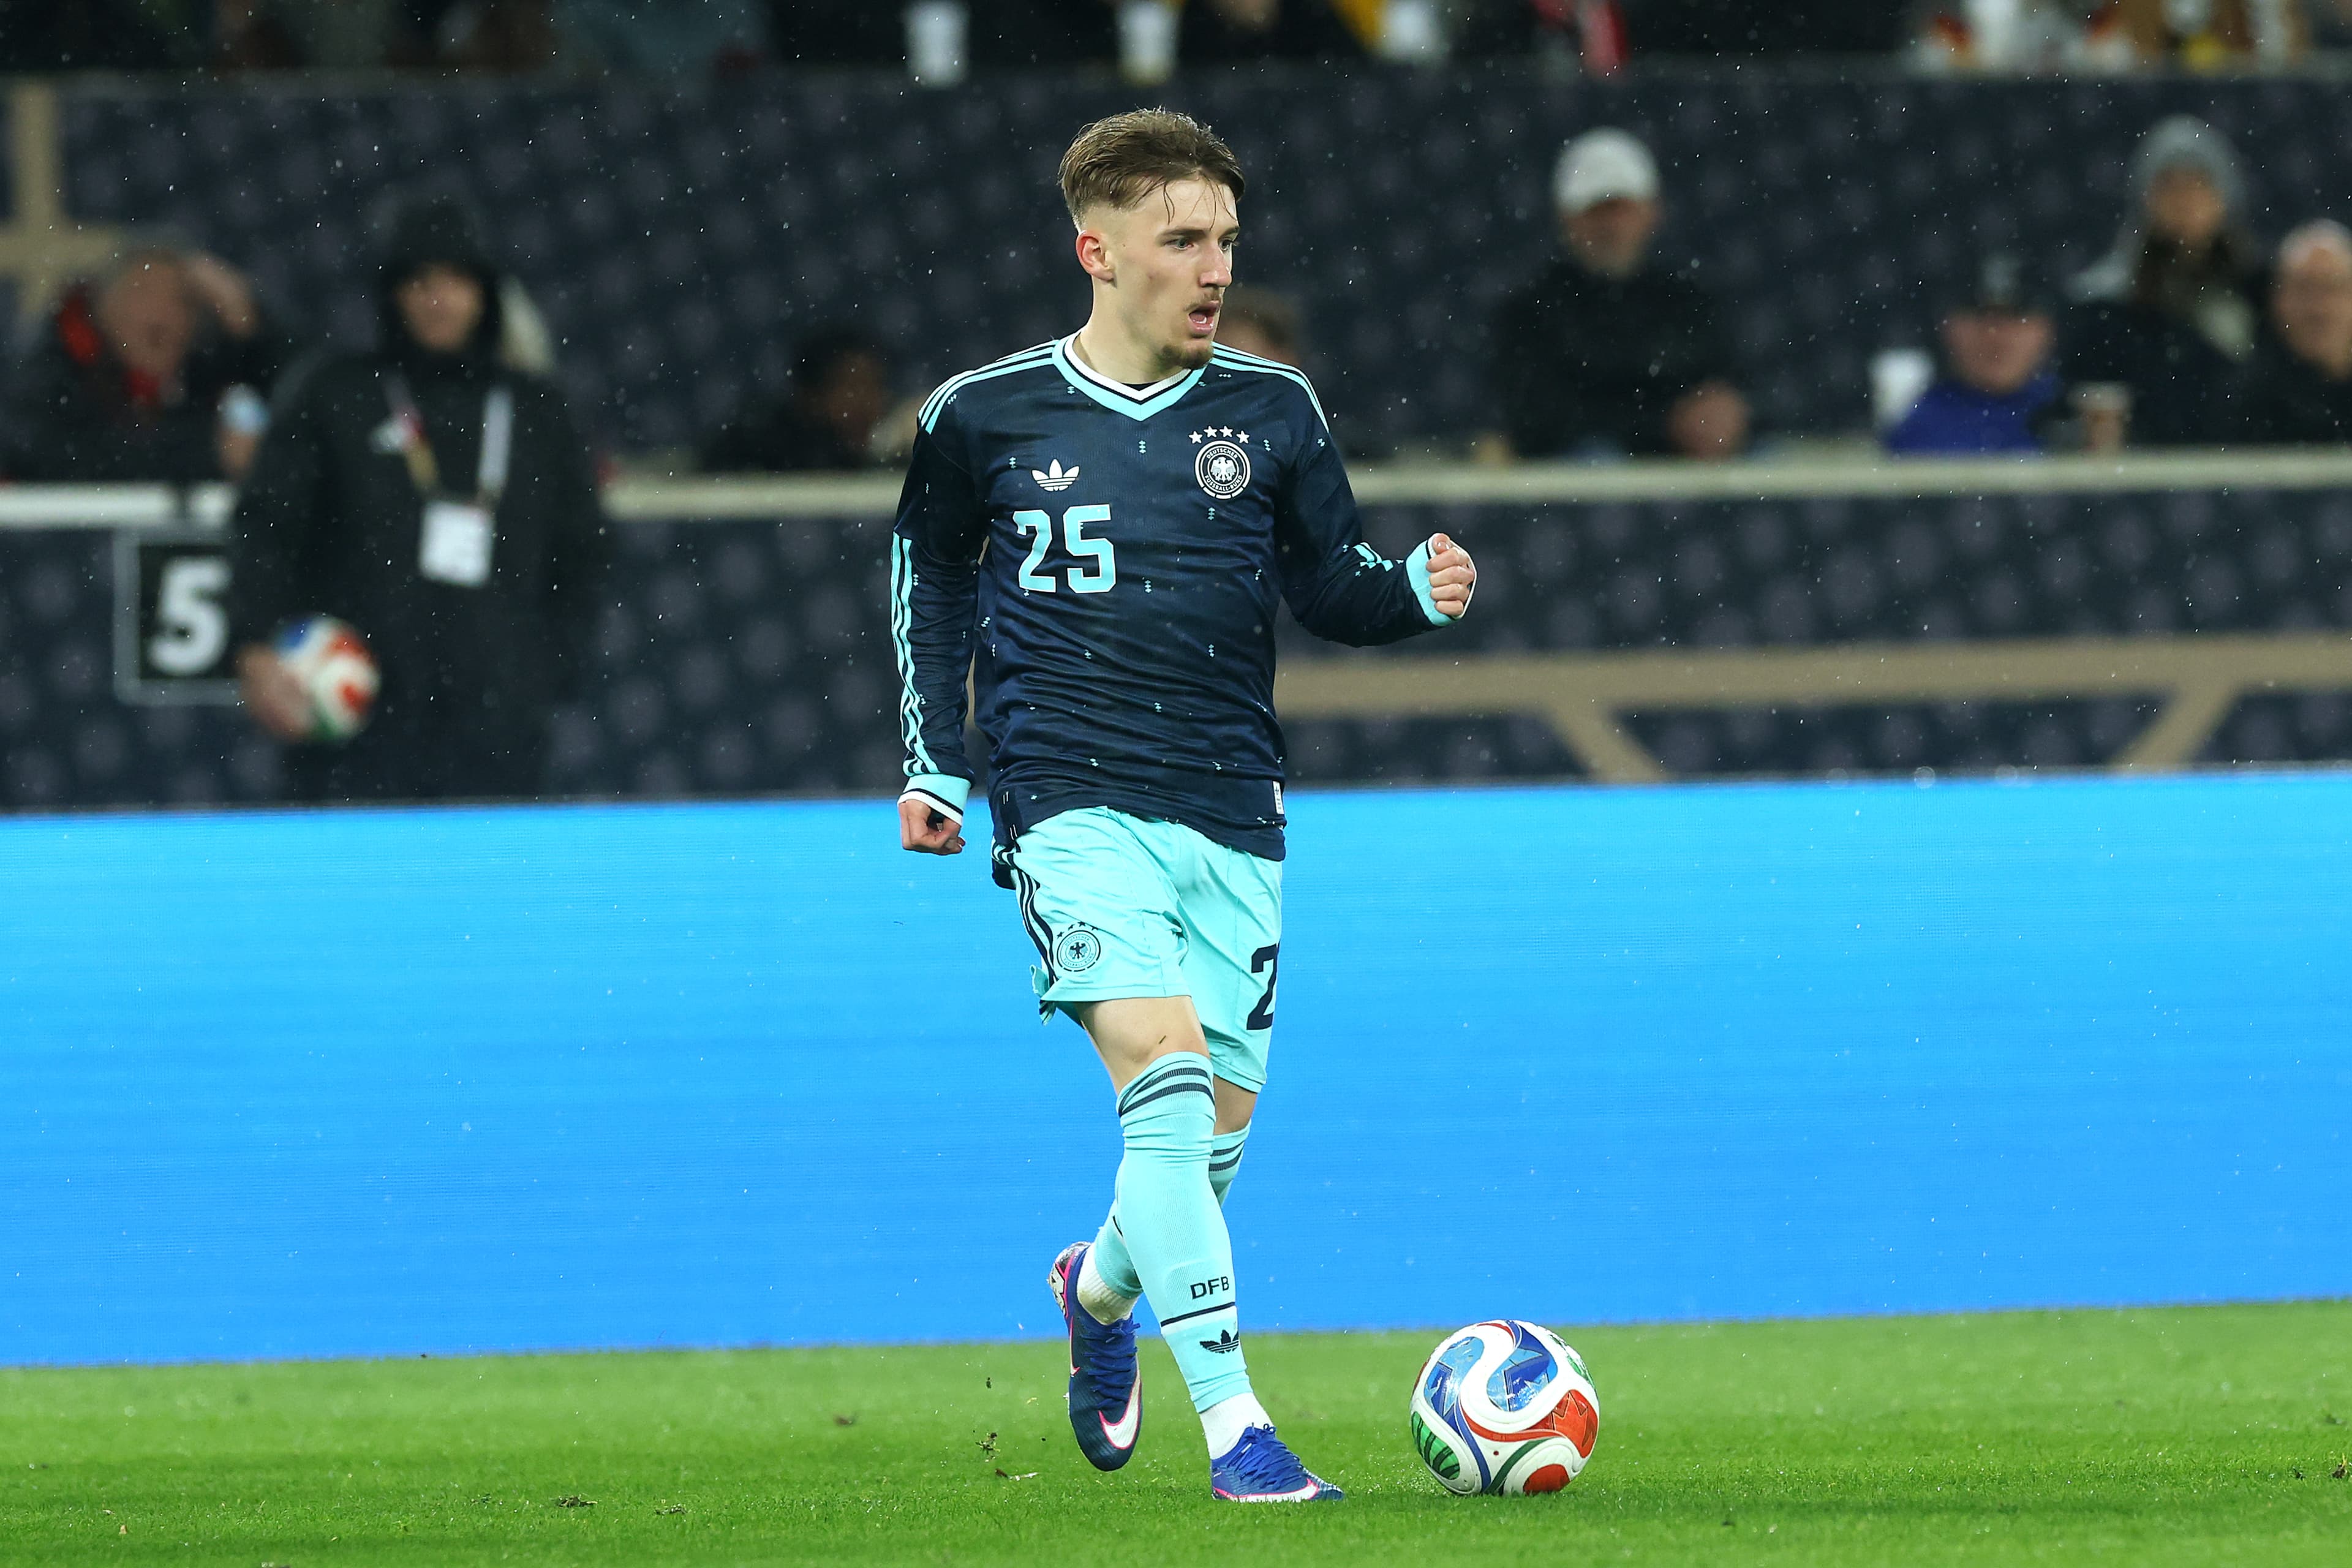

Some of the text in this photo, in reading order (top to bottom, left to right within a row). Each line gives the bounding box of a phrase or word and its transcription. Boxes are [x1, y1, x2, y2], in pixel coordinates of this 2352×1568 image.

[1206, 448, 1238, 459] DEUTSCHER
[1012, 503, 1116, 594] 25
[151, 556, 230, 675] 5
[1189, 1276, 1230, 1300] DFB
